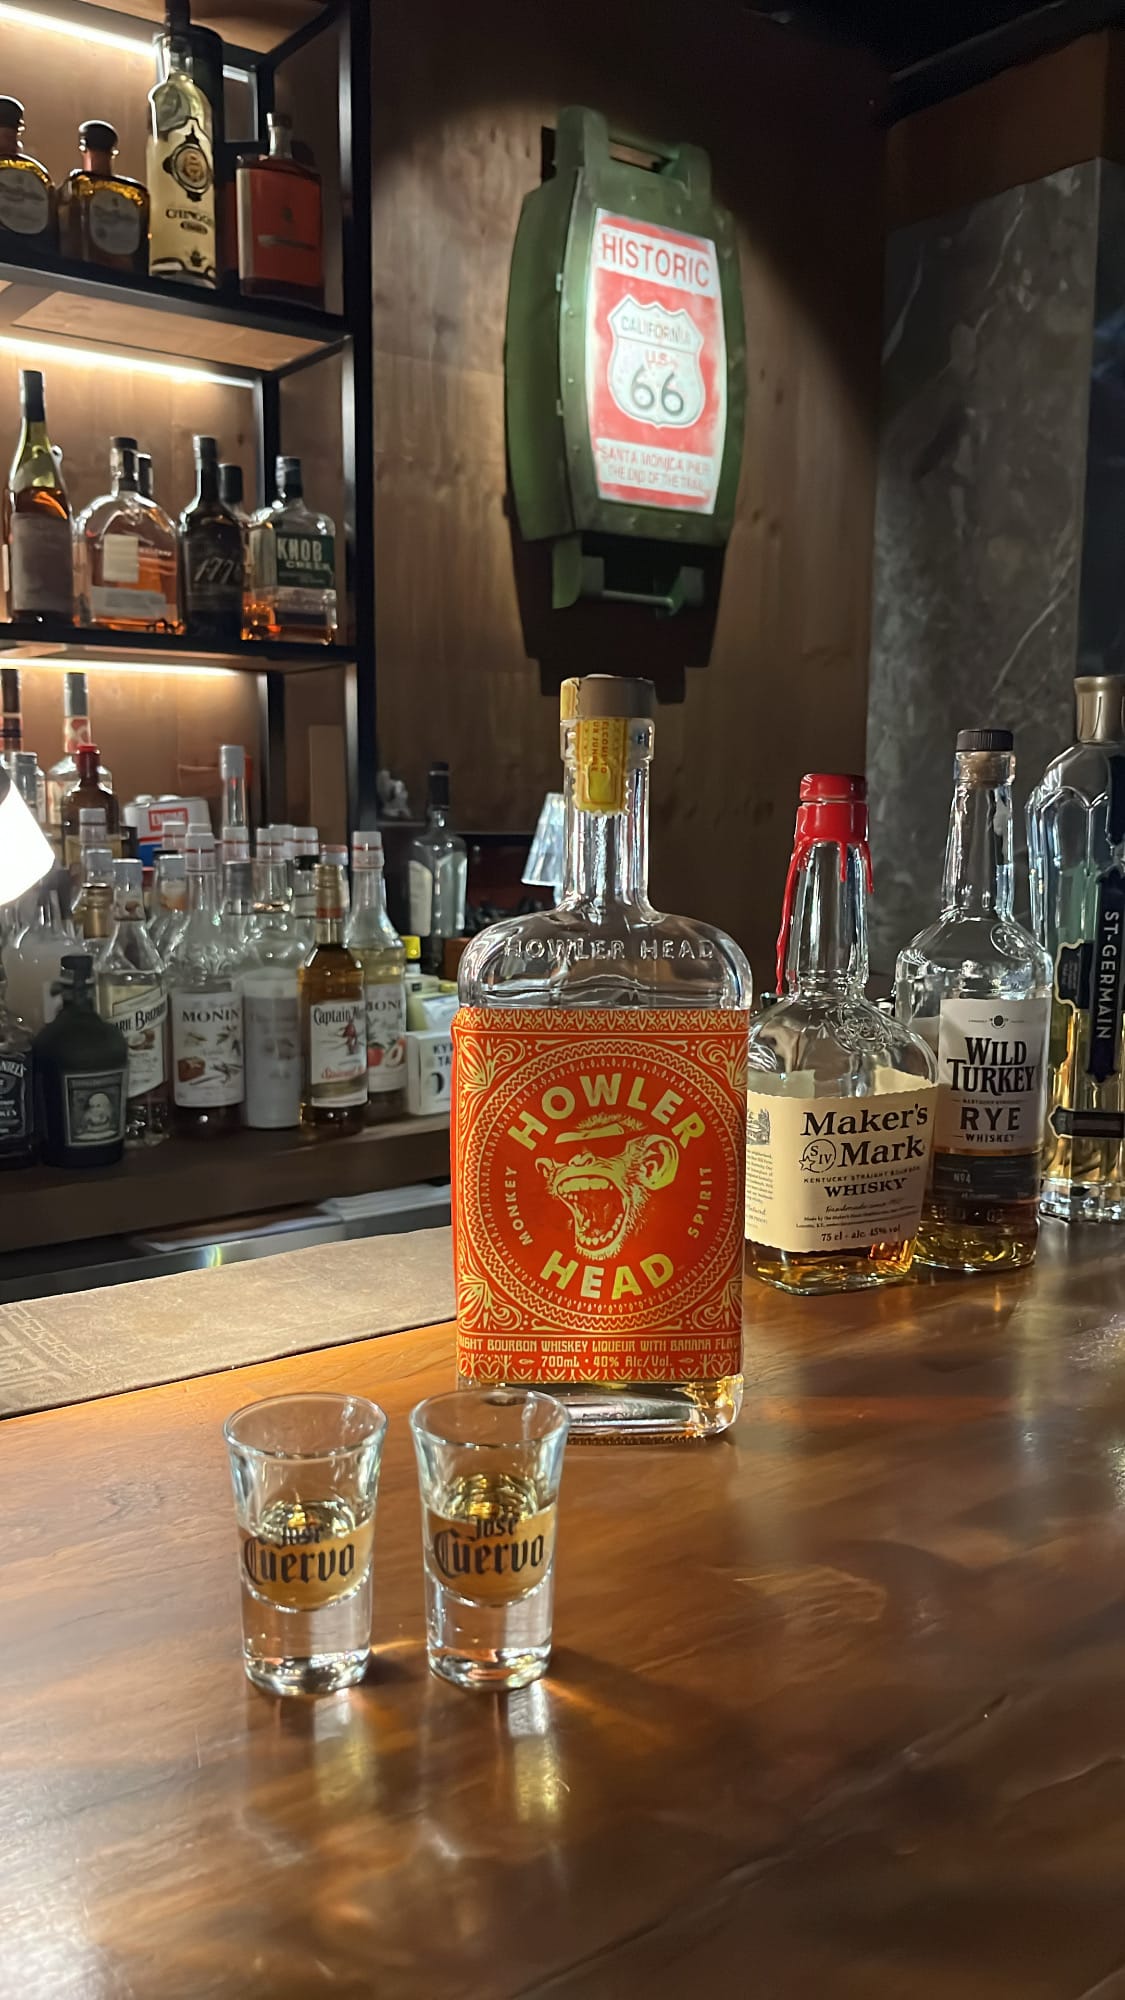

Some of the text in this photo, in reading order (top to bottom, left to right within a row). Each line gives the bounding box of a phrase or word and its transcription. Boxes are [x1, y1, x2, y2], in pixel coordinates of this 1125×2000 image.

[601, 232, 710, 288] HISTORIC
[621, 315, 691, 345] CALIFORNIA
[631, 364, 684, 416] 66
[600, 446, 638, 465] SANTA
[641, 452, 684, 473] MONICA
[277, 537, 322, 562] KNOB
[503, 937, 715, 961] HOWLER HEAD
[1095, 910, 1120, 1040] ST-GERMAIN
[182, 1008, 240, 1023] MONIN
[313, 1004, 350, 1027] Captain
[964, 1036, 1028, 1067] WILD
[946, 1057, 1036, 1097] TURKEY
[507, 1072, 706, 1151] HOWLER
[800, 1103, 929, 1137] Maker's
[960, 1106, 1022, 1131] RYE
[836, 1134, 925, 1169] Mark
[964, 1133, 1016, 1143] WHISKEY
[803, 1174, 848, 1184] KENTUCKY
[850, 1170, 888, 1181] STRAIGHT
[823, 1177, 908, 1199] WHISKY
[504, 1165, 534, 1247] MONKEY
[686, 1166, 712, 1239] SPIRIT
[821, 1232, 833, 1242] 75
[834, 1230, 843, 1240] cl
[539, 1250, 675, 1300] HEAD
[487, 1339, 538, 1353] BOURBON
[541, 1340, 589, 1353] WHISKEY
[592, 1340, 636, 1353] LIQUEUR
[640, 1340, 667, 1352] WITH
[670, 1339, 712, 1352] BANANA
[541, 1354, 673, 1369] 700mL 40% Alc/Vol.
[244, 1537, 355, 1585] Cuervo
[433, 1528, 544, 1578] Cuervo
